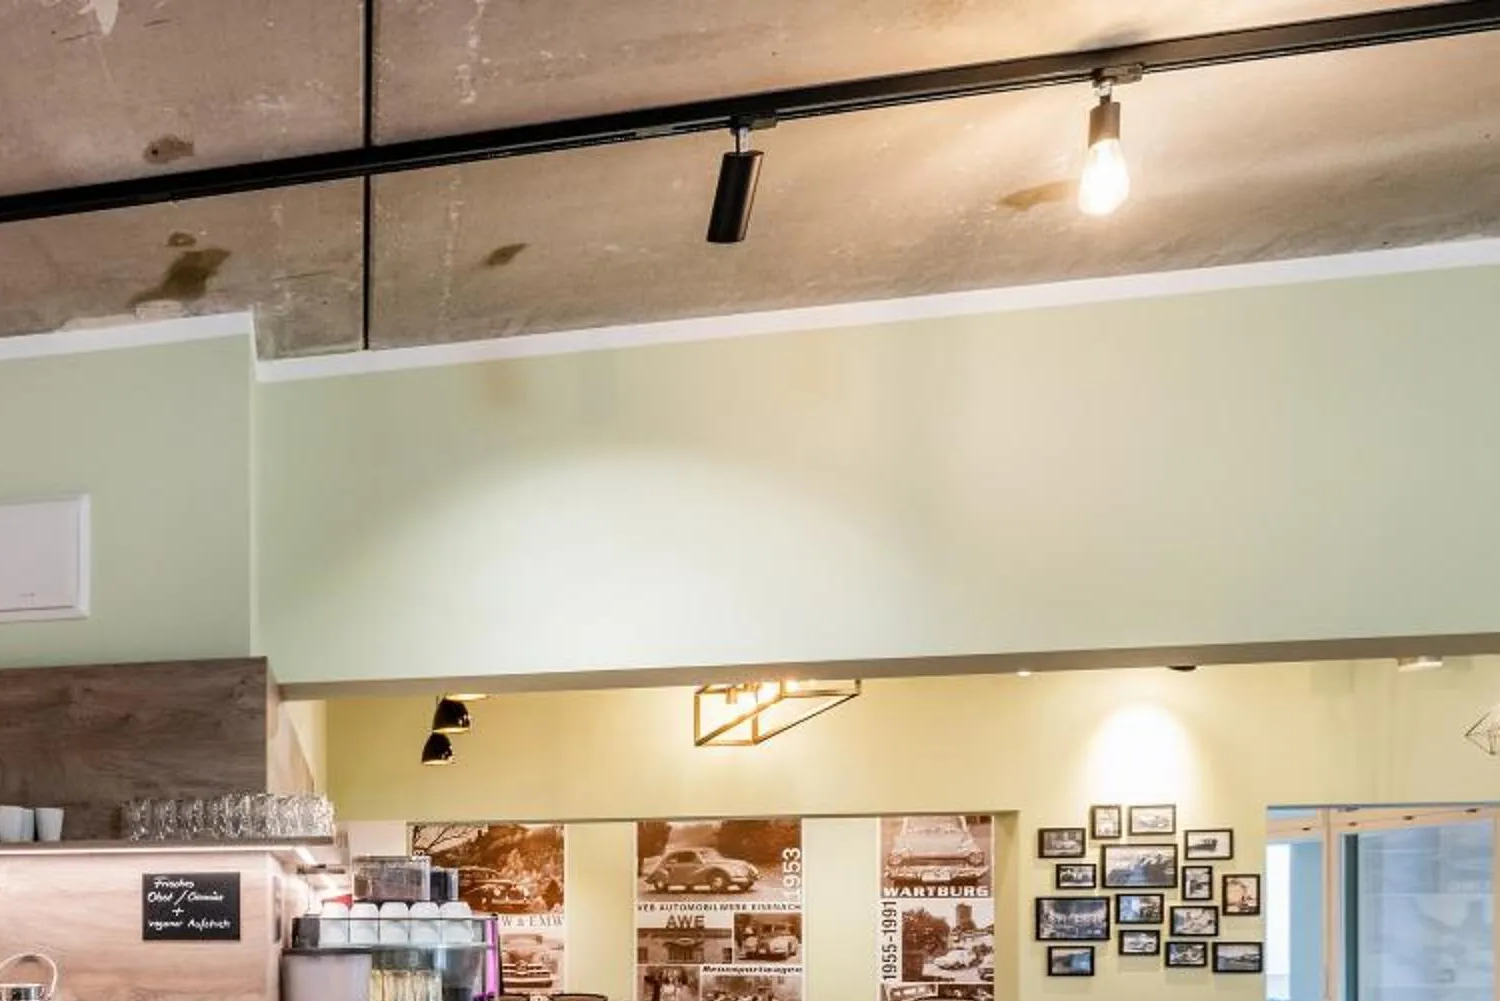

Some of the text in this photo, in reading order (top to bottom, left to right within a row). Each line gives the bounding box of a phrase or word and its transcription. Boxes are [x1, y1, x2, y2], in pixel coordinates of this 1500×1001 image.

[782, 847, 800, 900] 1953
[883, 885, 989, 898] WARTBURG
[665, 914, 705, 930] AWE
